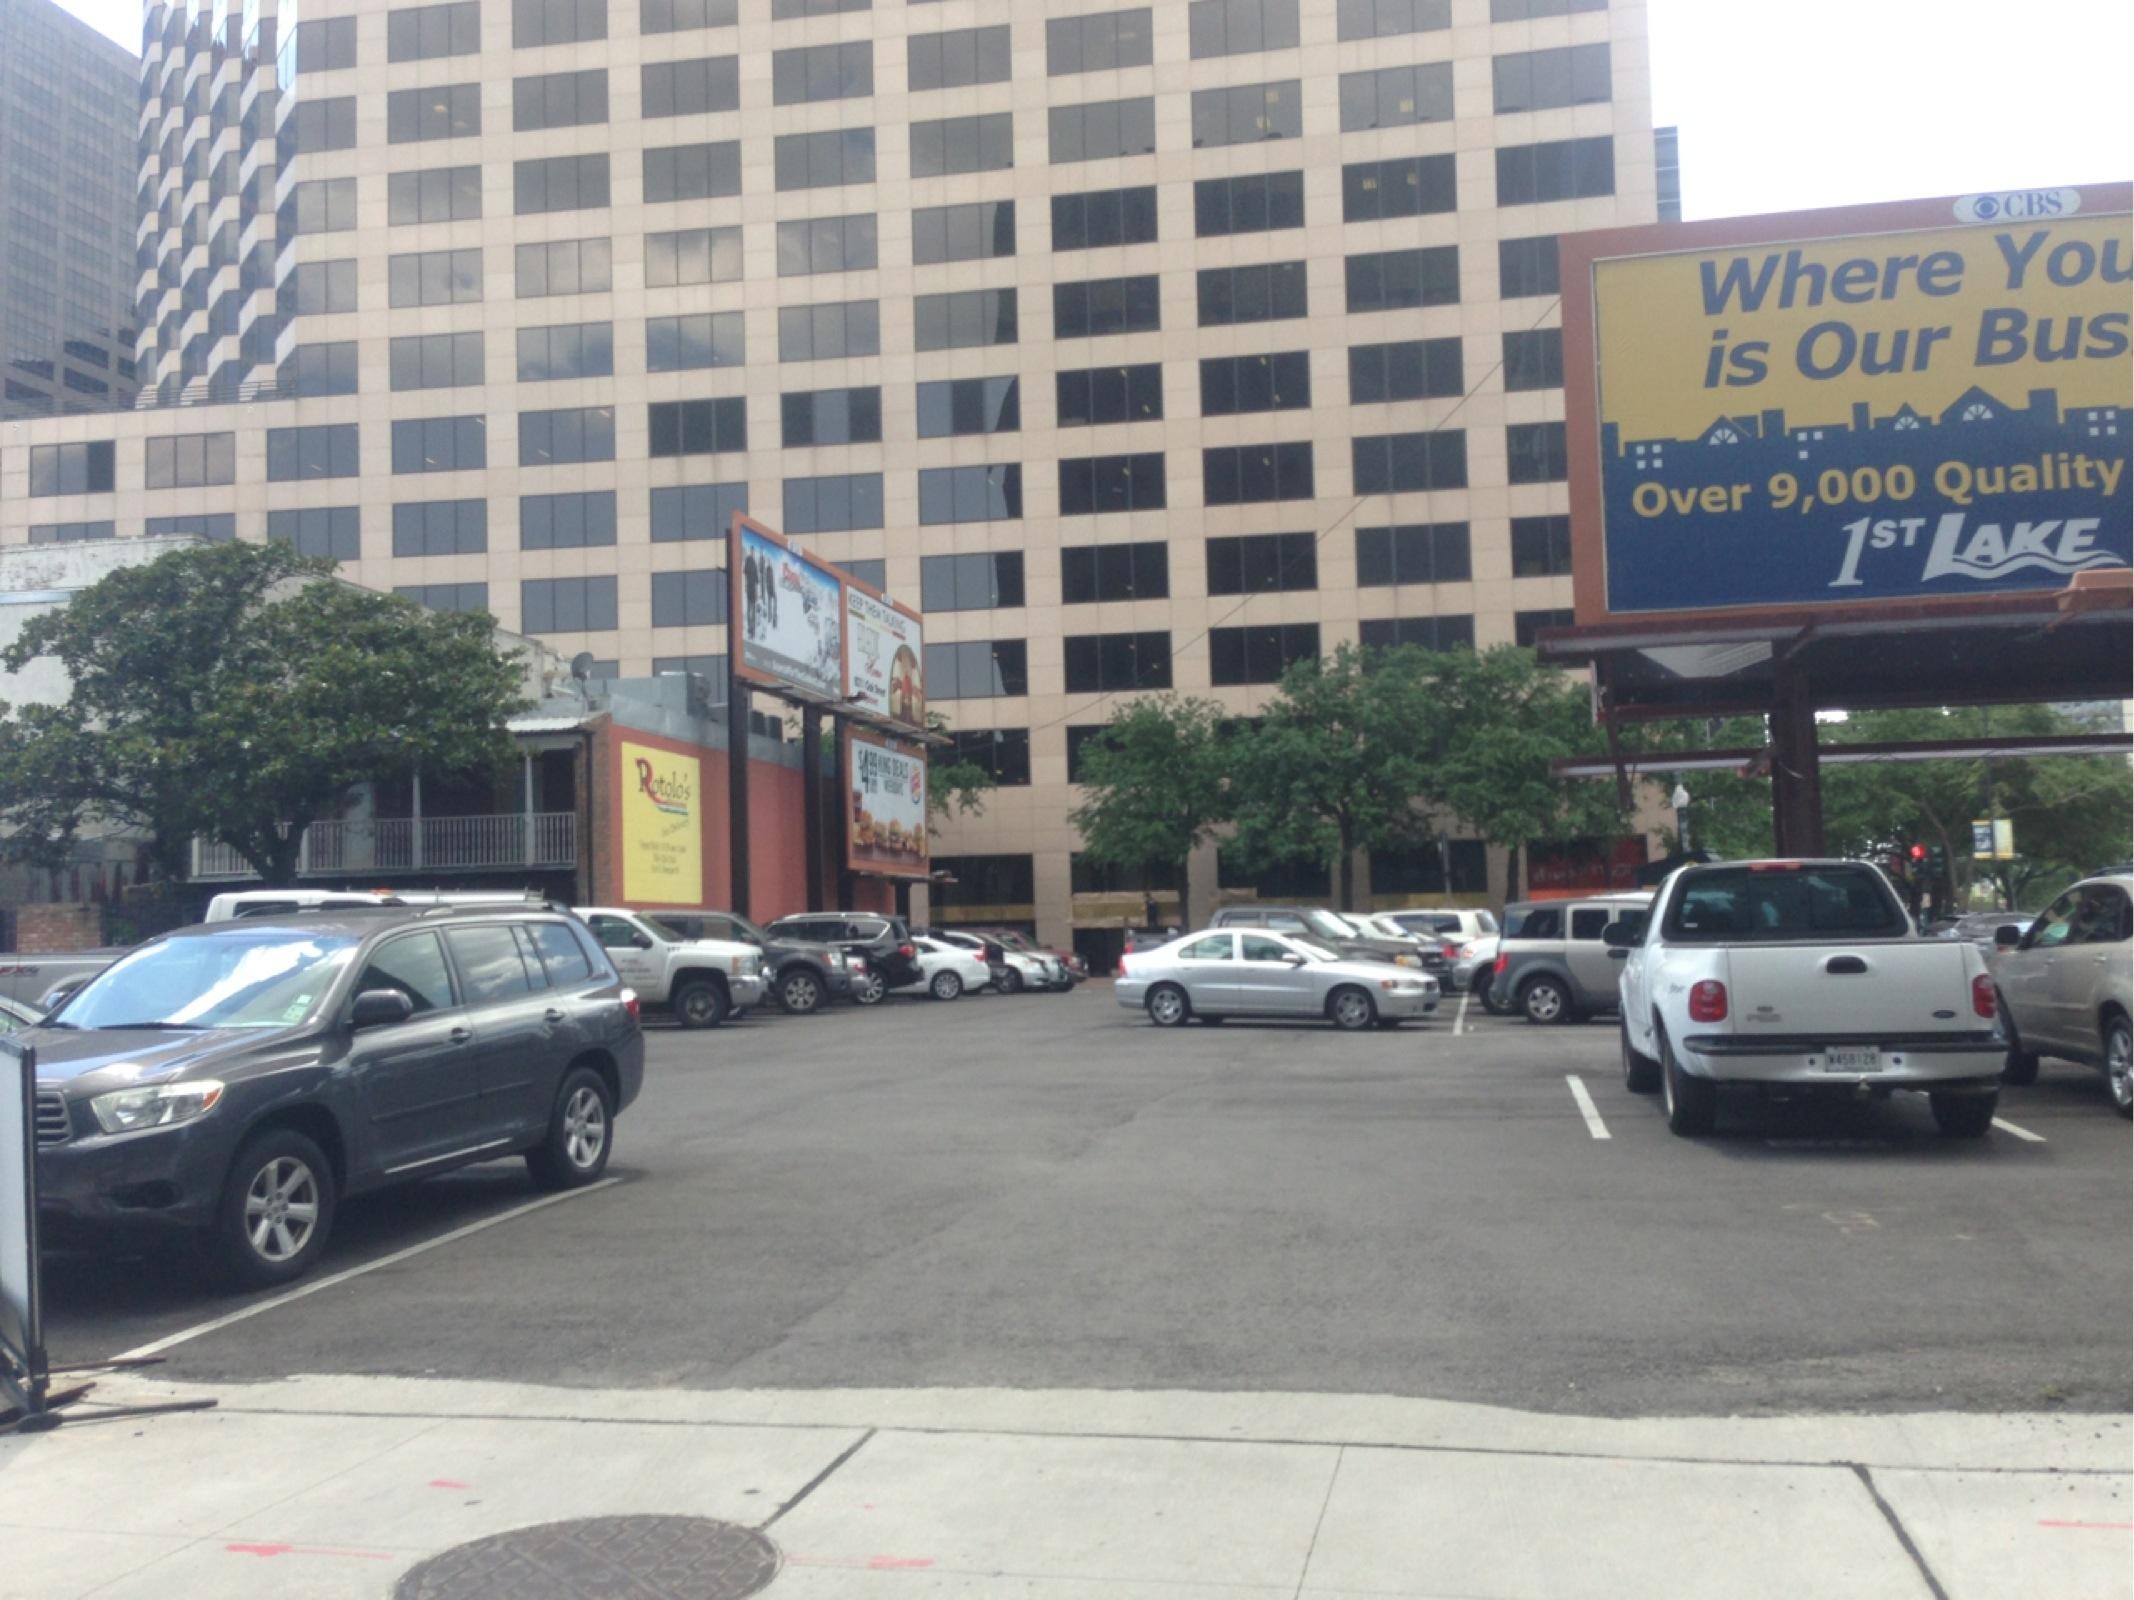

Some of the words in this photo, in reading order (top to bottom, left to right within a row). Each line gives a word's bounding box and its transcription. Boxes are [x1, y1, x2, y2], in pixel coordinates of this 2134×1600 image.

[2004, 190, 2063, 217] CBS
[1700, 250, 1965, 317] Where
[1704, 329, 1768, 388] is
[1795, 320, 1951, 380] Our
[1632, 480, 1751, 518] Over
[1768, 464, 1916, 514] 9,000
[1934, 453, 2125, 502] Quality
[1922, 512, 2102, 583] LAKE
[634, 757, 691, 802] Rotolo's
